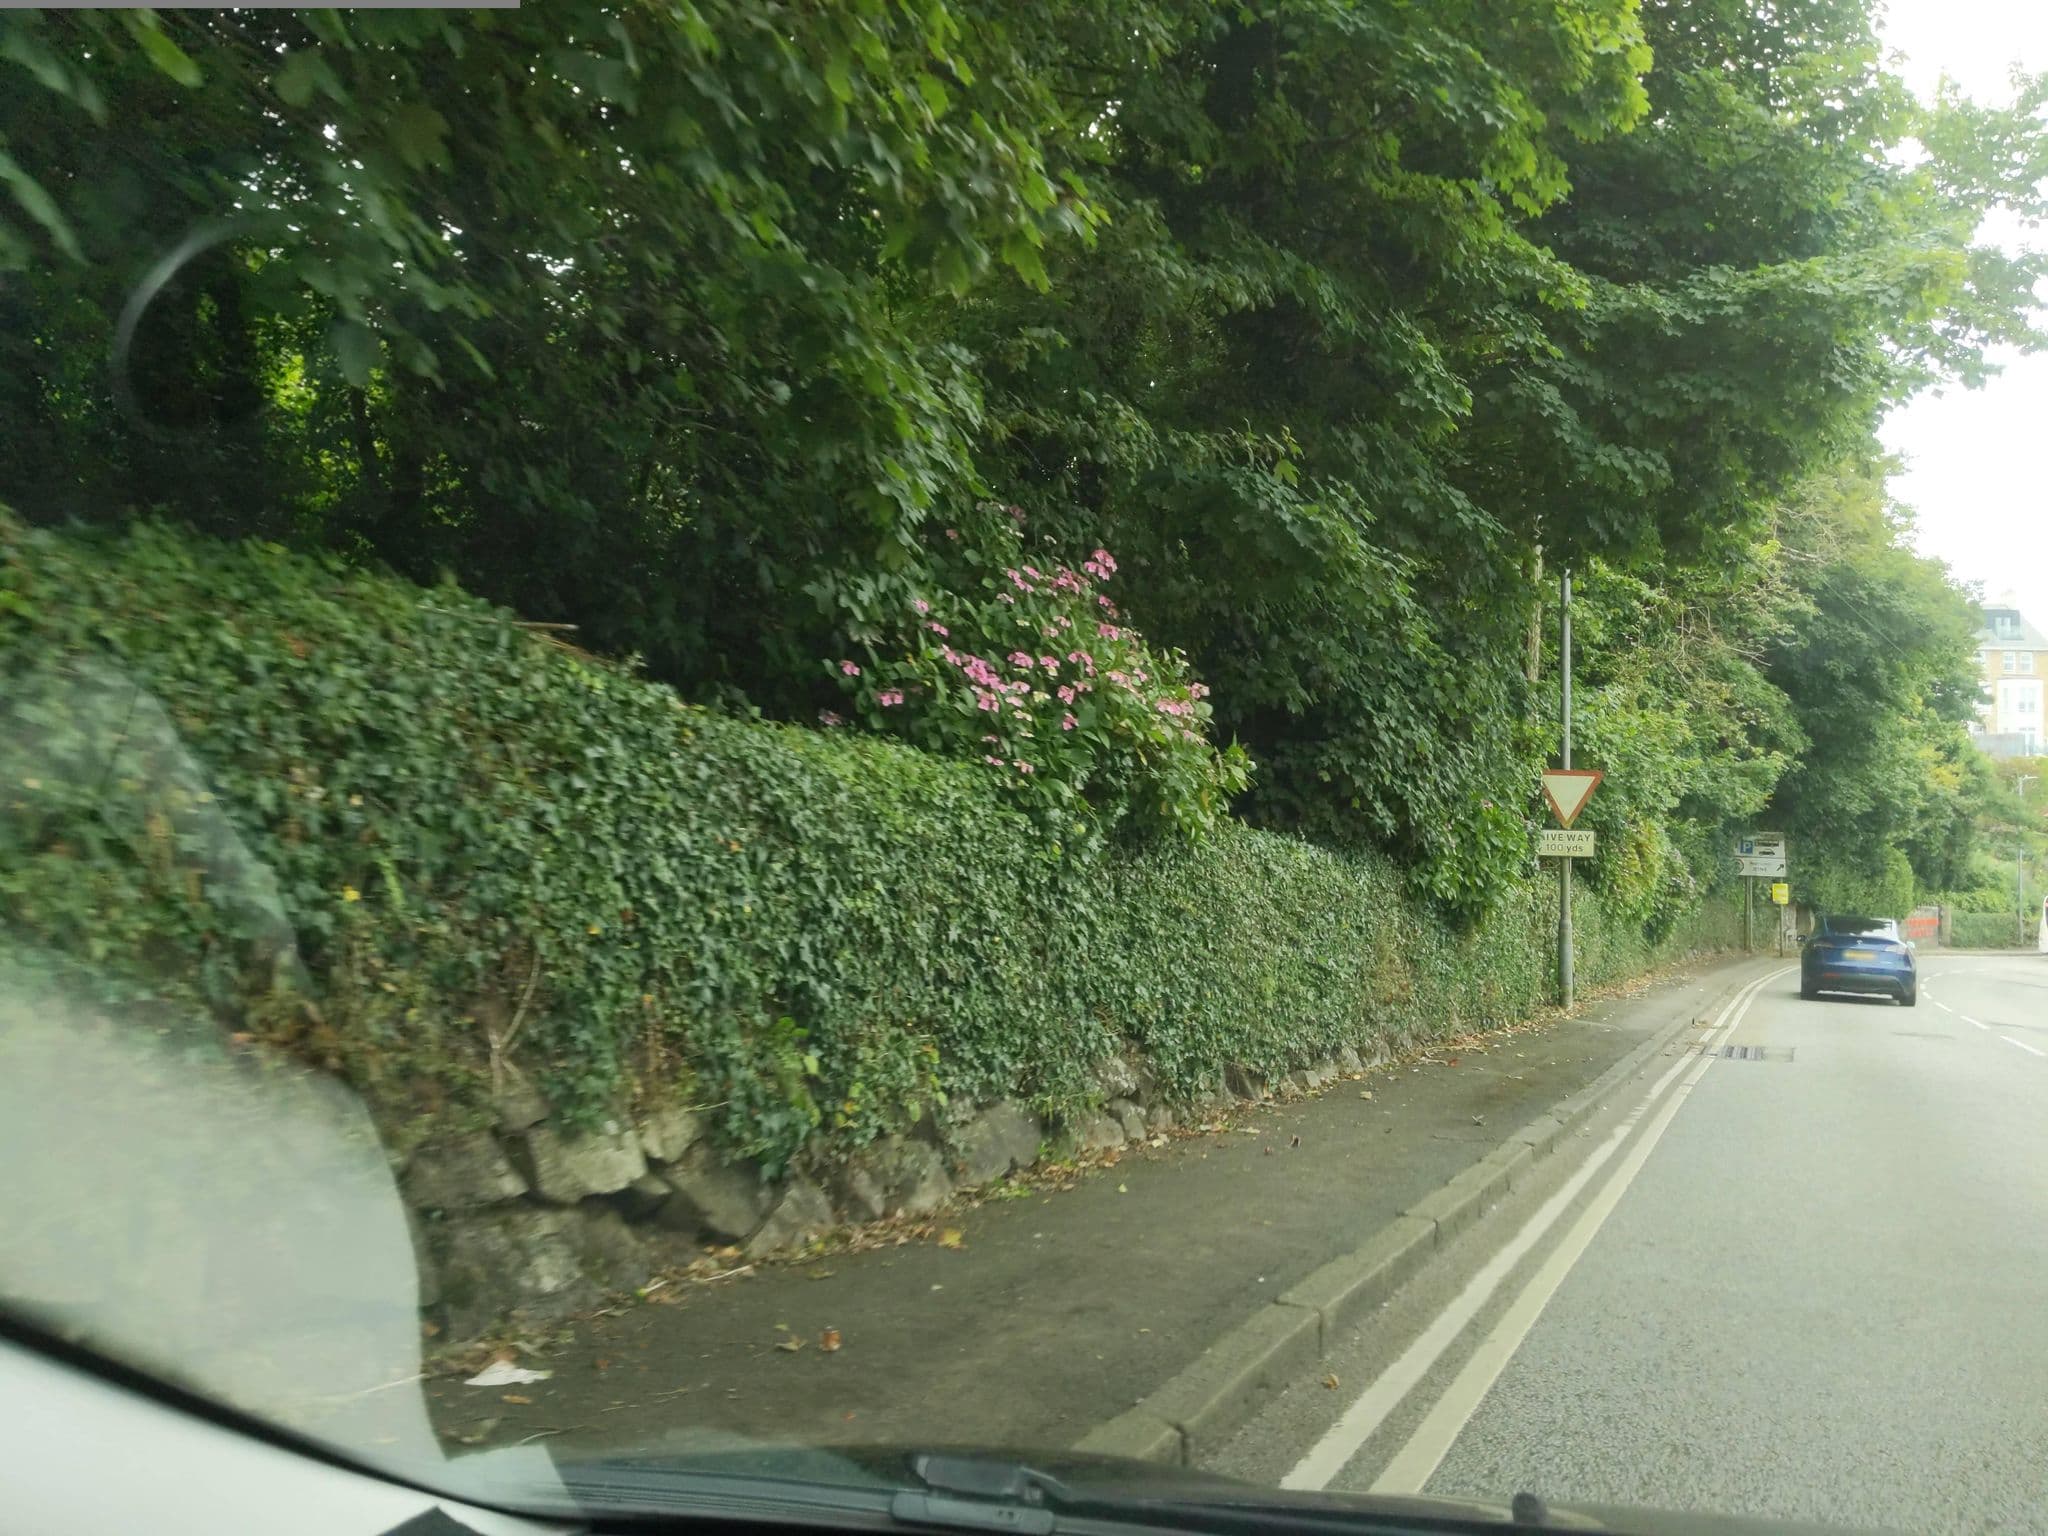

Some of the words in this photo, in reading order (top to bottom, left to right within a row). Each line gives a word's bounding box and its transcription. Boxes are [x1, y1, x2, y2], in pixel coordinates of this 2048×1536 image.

[1566, 834, 1591, 842] WAY
[1546, 843, 1563, 851] 100
[1566, 844, 1584, 853] yds
[1743, 842, 1751, 852] P
